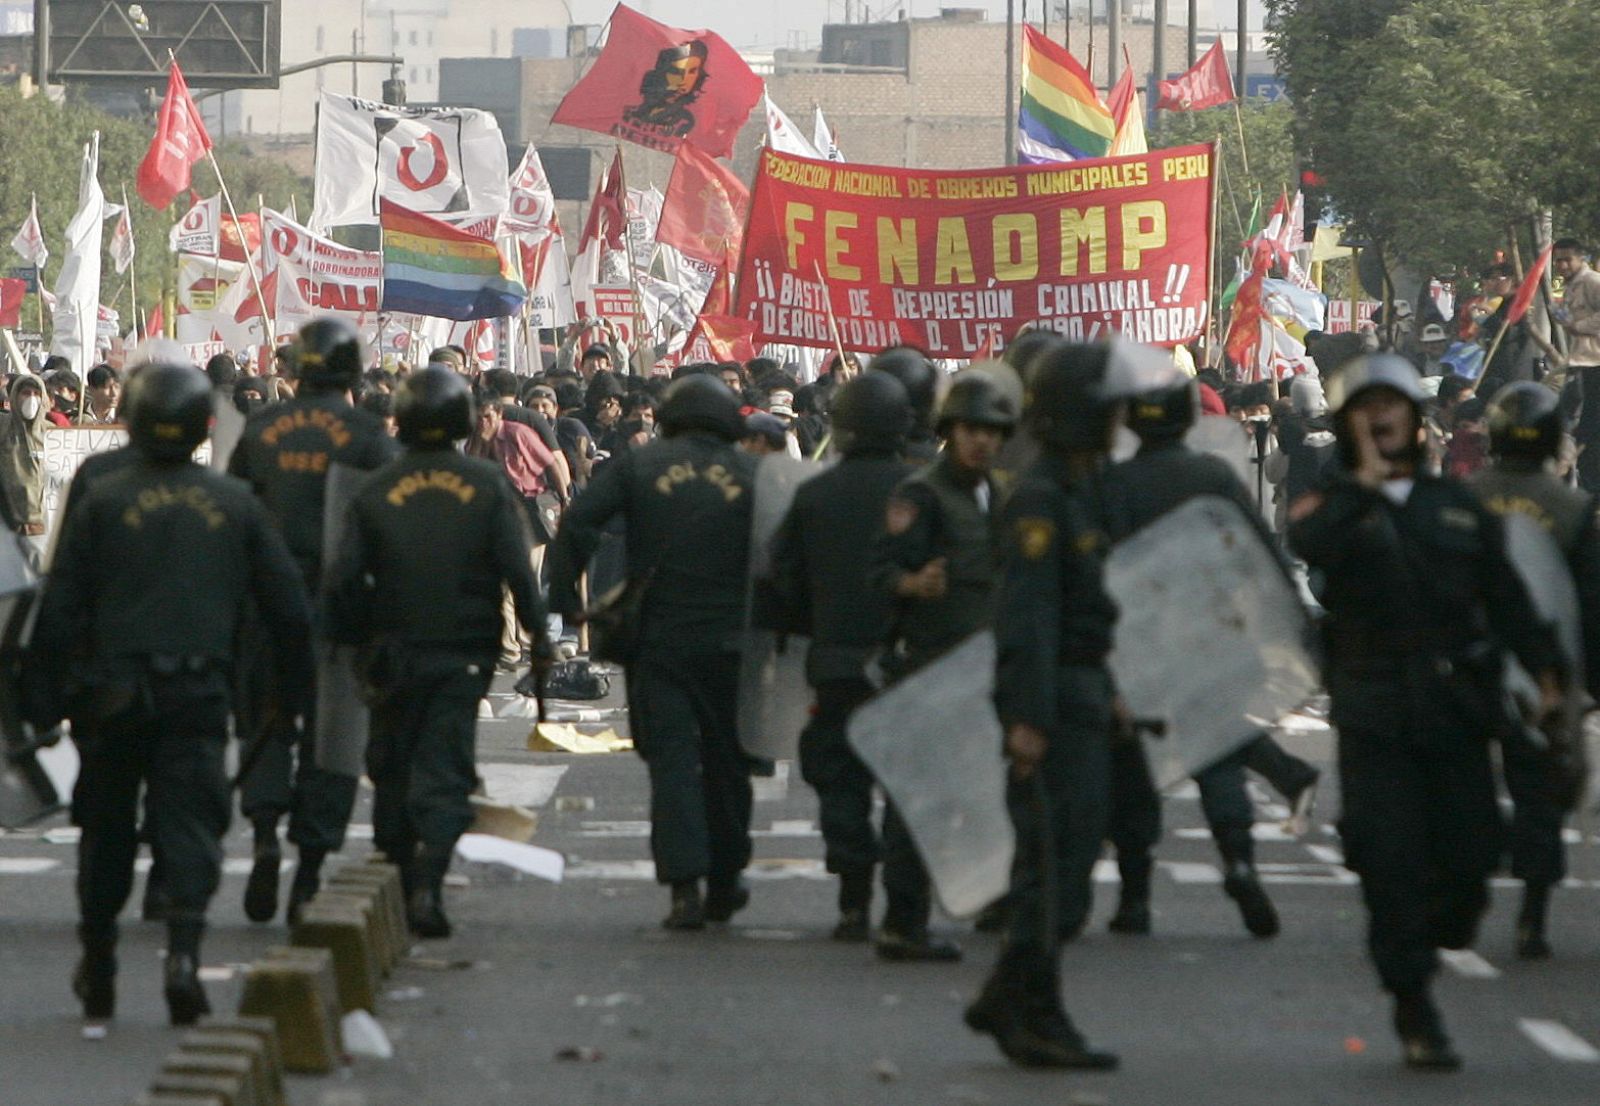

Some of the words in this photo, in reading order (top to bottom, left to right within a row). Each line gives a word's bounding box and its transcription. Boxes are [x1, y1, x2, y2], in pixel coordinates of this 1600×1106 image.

[832, 170, 902, 198] NACIONAL
[908, 177, 932, 198] DE
[936, 176, 1018, 199] OBREROS
[1027, 162, 1148, 196] MUNICIPALES
[1162, 154, 1209, 182] PERU
[785, 200, 1167, 285] FENAOMP
[847, 288, 873, 317] DE
[892, 278, 1013, 319] REPRESIÓN
[926, 320, 949, 351] D.
[46, 430, 121, 451] SELVA
[386, 470, 476, 506] POLICIA
[656, 460, 742, 501] POLCIA
